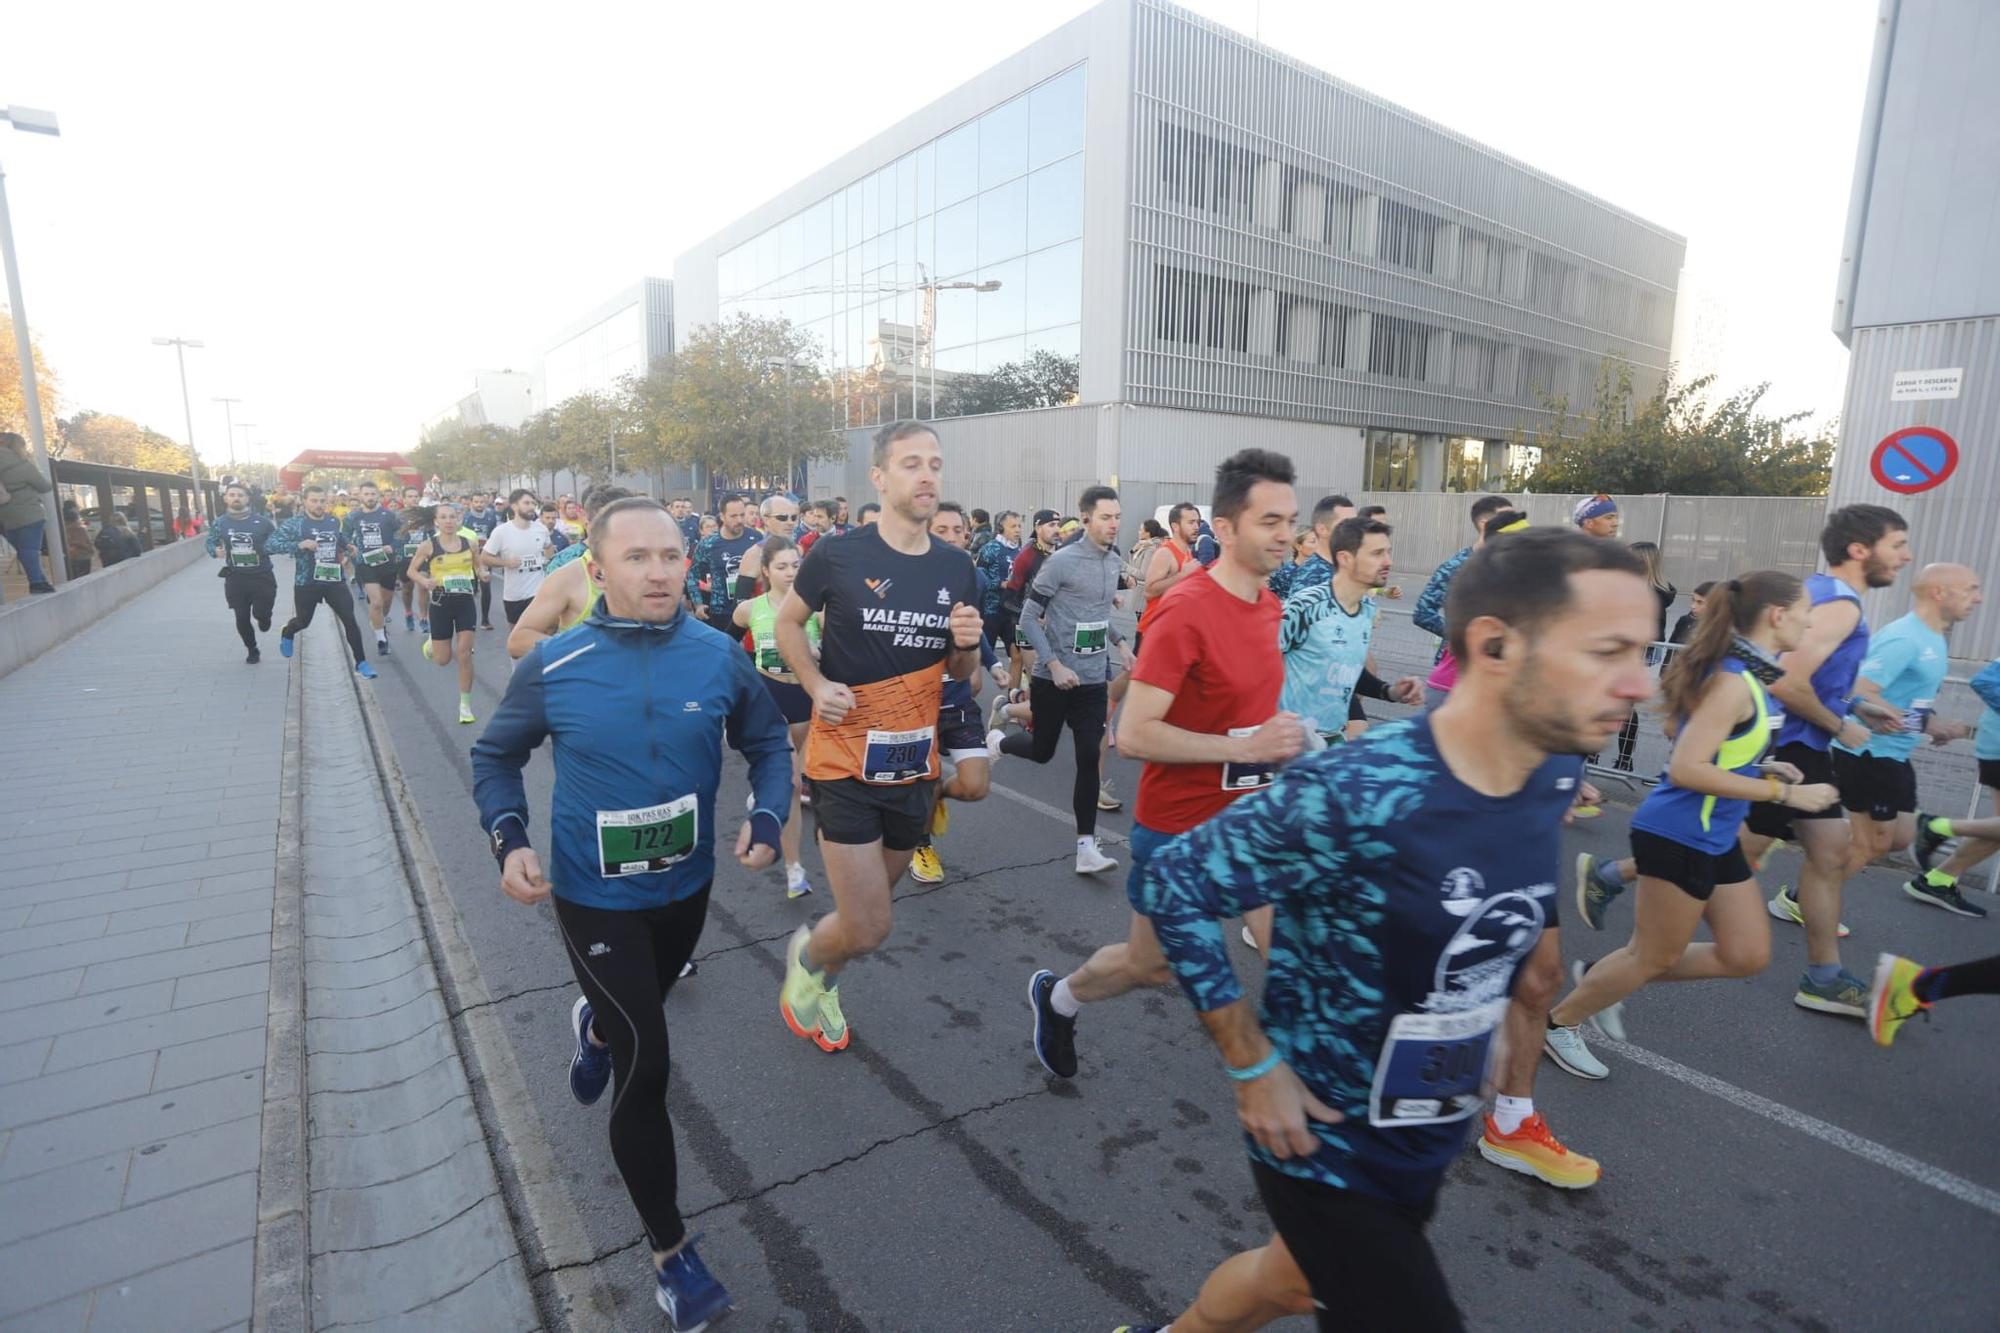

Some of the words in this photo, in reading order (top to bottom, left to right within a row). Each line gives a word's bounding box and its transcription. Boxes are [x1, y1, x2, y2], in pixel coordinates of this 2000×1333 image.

[862, 623, 896, 632] MAKES
[898, 626, 918, 634] YOU
[886, 745, 917, 764] 230
[631, 823, 673, 851] 722
